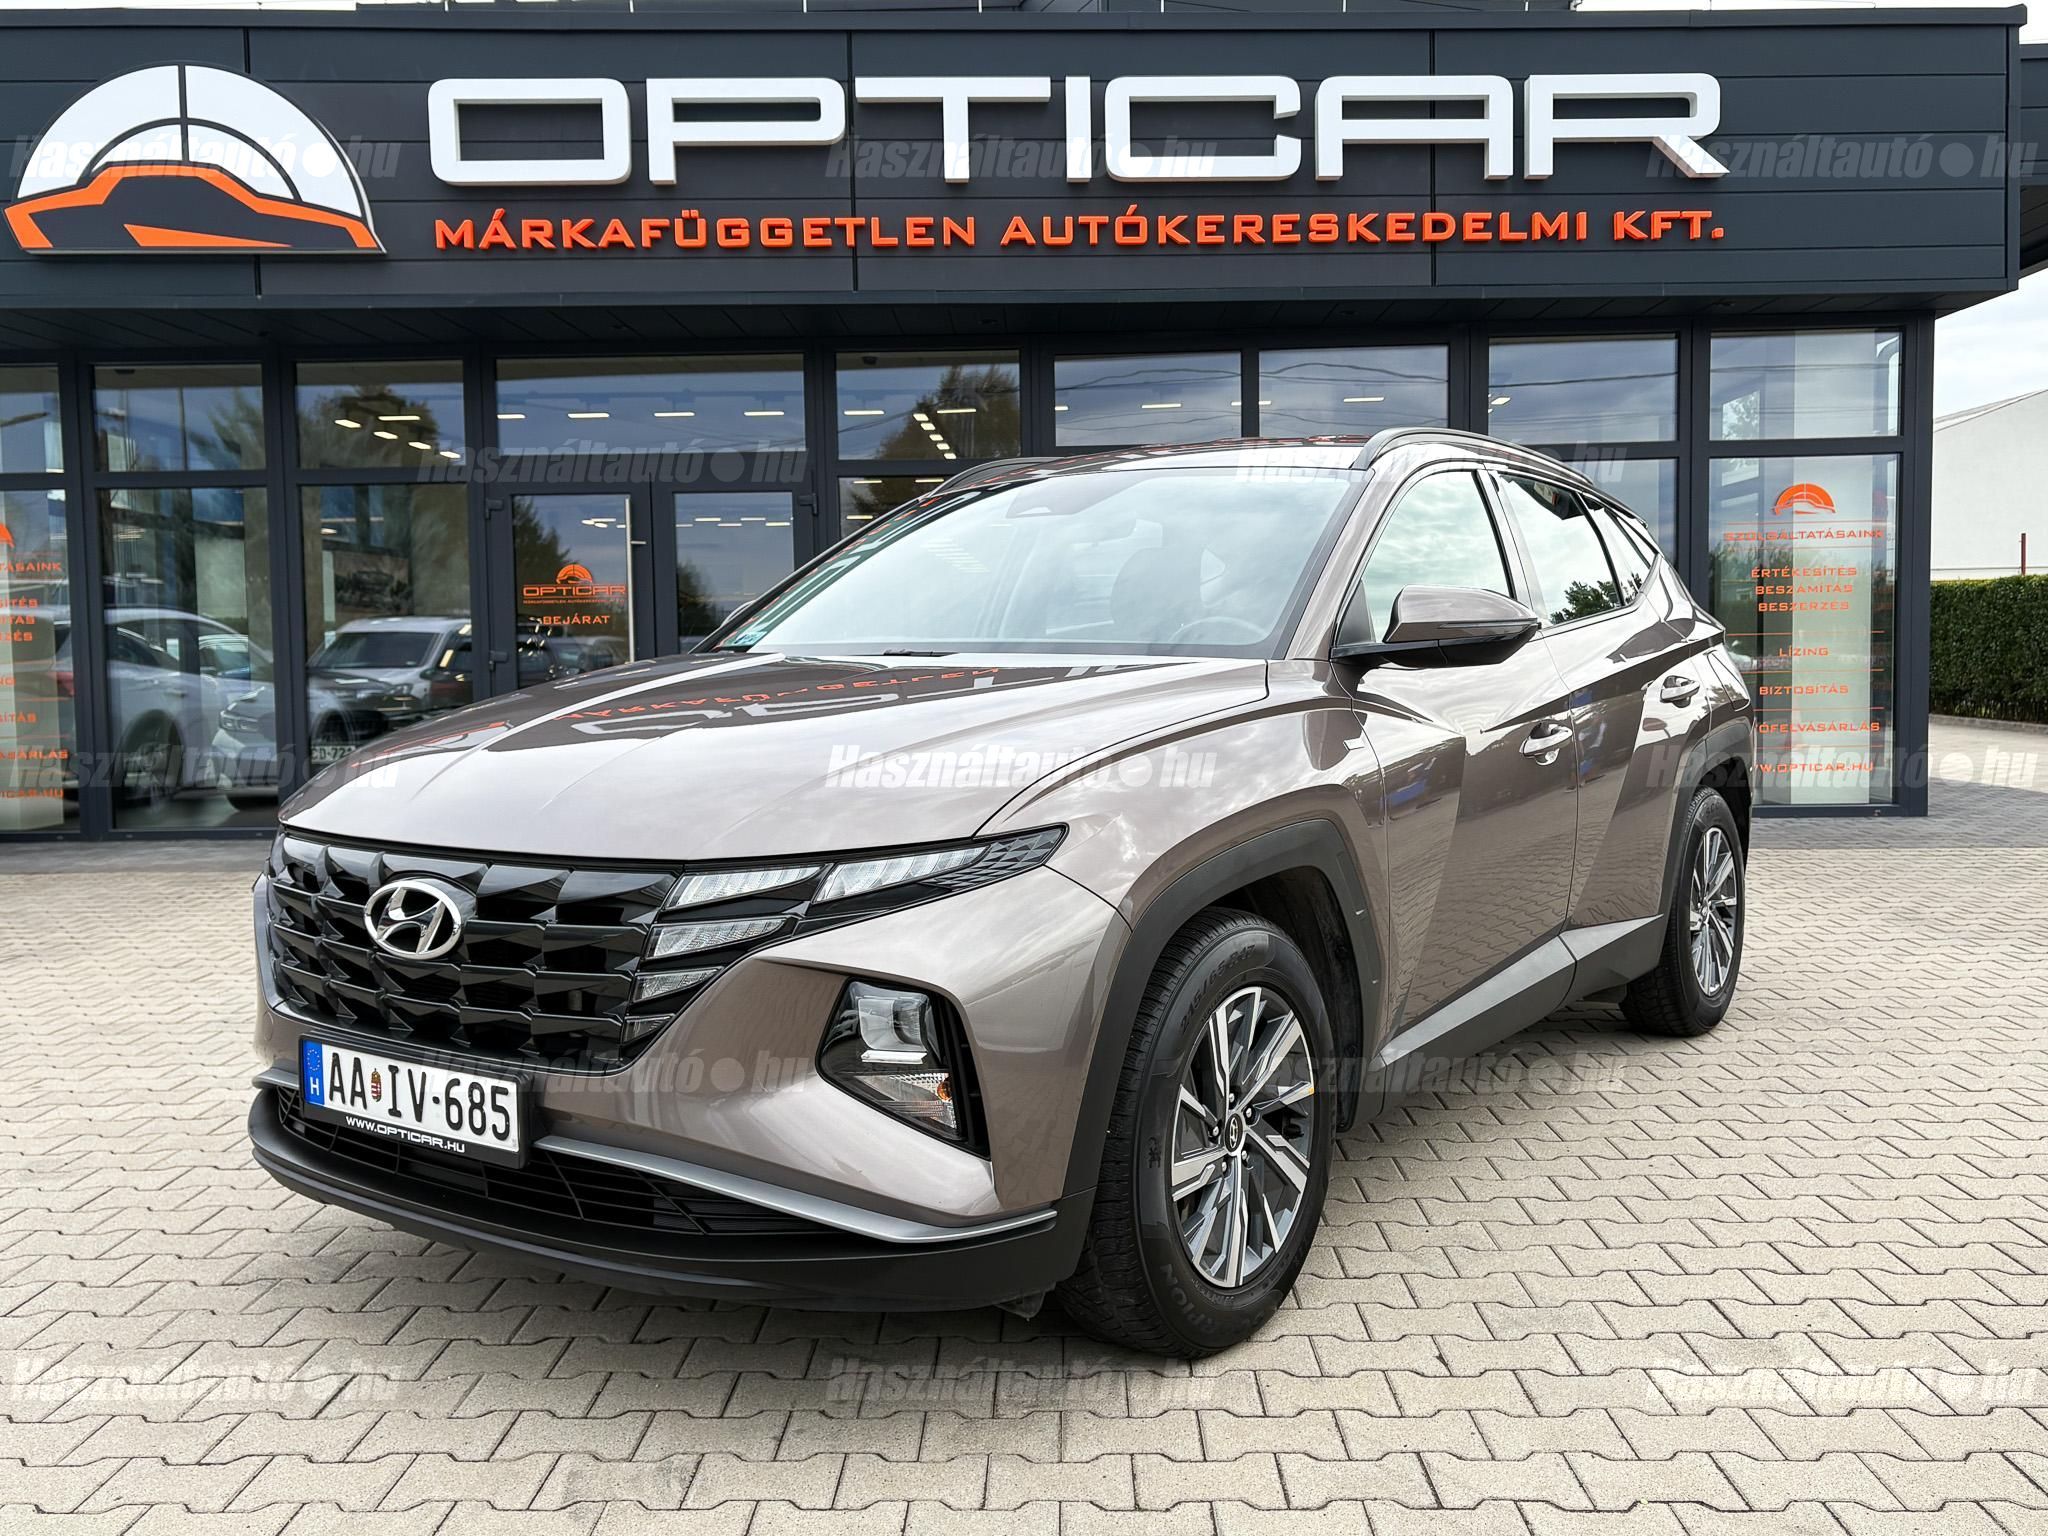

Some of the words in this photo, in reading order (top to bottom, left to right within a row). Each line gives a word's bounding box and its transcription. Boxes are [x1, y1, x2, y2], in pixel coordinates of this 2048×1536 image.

[427, 73, 1730, 186] OPTICAR
[434, 207, 974, 250] MÁRKAFÜGGETLEN
[1000, 204, 1587, 246] AUTÓKERESKEDELMI
[1613, 211, 1724, 241] KFT.
[1751, 567, 1857, 578] ÉRTÉKESÍTÉS
[523, 586, 626, 597] OPTICAR
[1755, 584, 1853, 595] BESZÁMÍTÁS
[1758, 600, 1849, 612] BESZERZÉS
[543, 613, 610, 625] BEJÁRAT
[1779, 645, 1829, 657] LÍZING
[1759, 683, 1849, 696] BIZTOSÍTÁS
[1756, 721, 1880, 734] ÓFELVÁSÁRLÁS
[1756, 761, 1873, 773] W.OPTICAR.HU
[310, 1076, 320, 1097] H
[329, 1052, 368, 1110] AA
[388, 1064, 510, 1141] IV-685
[346, 1115, 466, 1154] WWW.OPTICAR.HU
